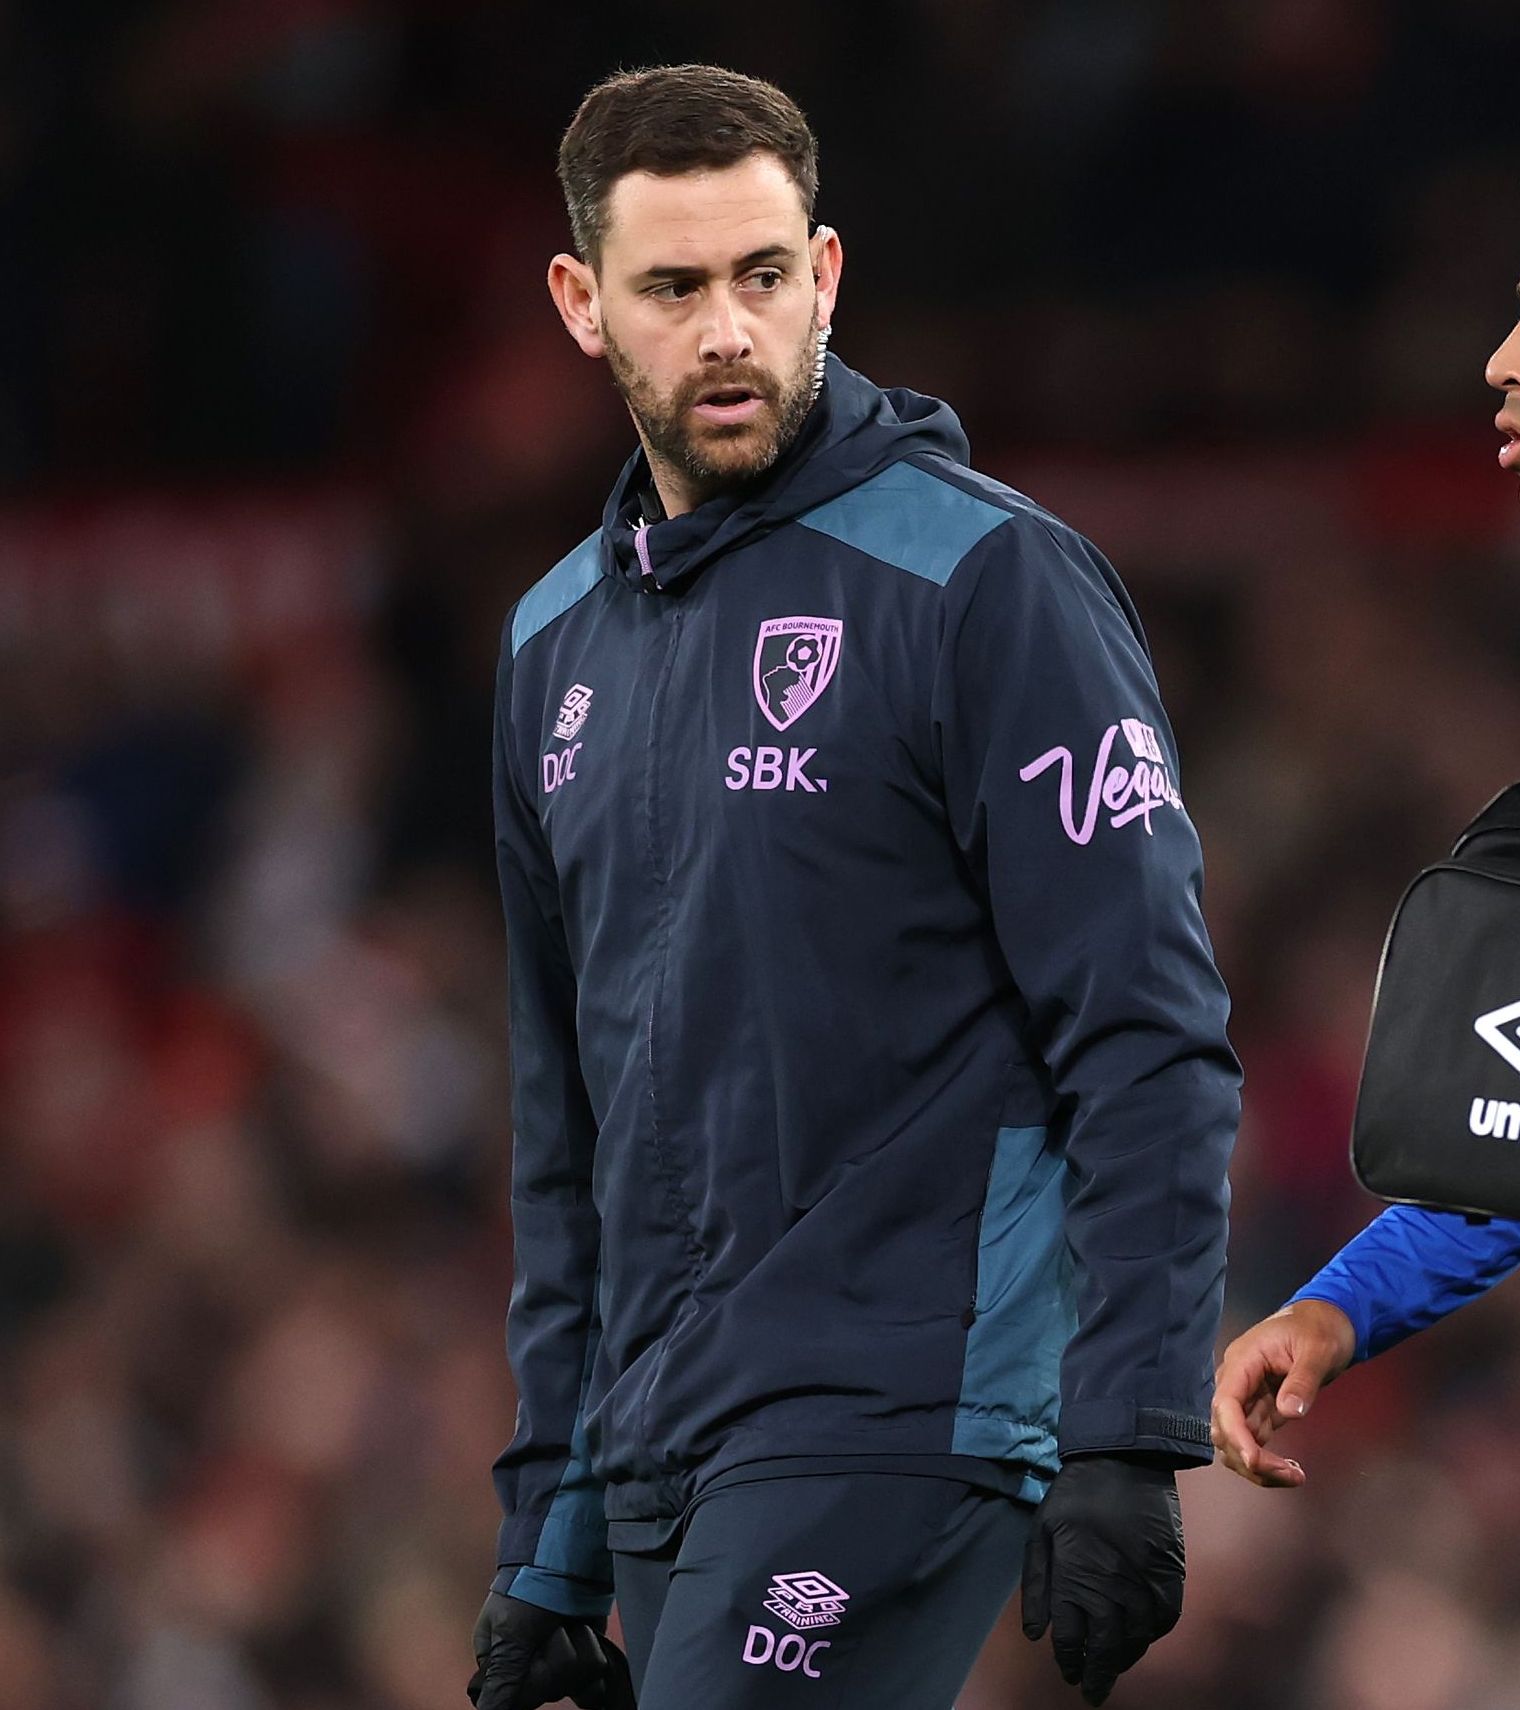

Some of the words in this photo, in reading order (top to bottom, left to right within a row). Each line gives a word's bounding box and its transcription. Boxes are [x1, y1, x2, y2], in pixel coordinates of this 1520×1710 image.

[765, 623, 781, 633] AFC
[782, 622, 839, 632] BOURNEMOUTH
[543, 742, 583, 793] DOC
[773, 1603, 834, 1626] TRAINING
[742, 1625, 832, 1678] DOC
